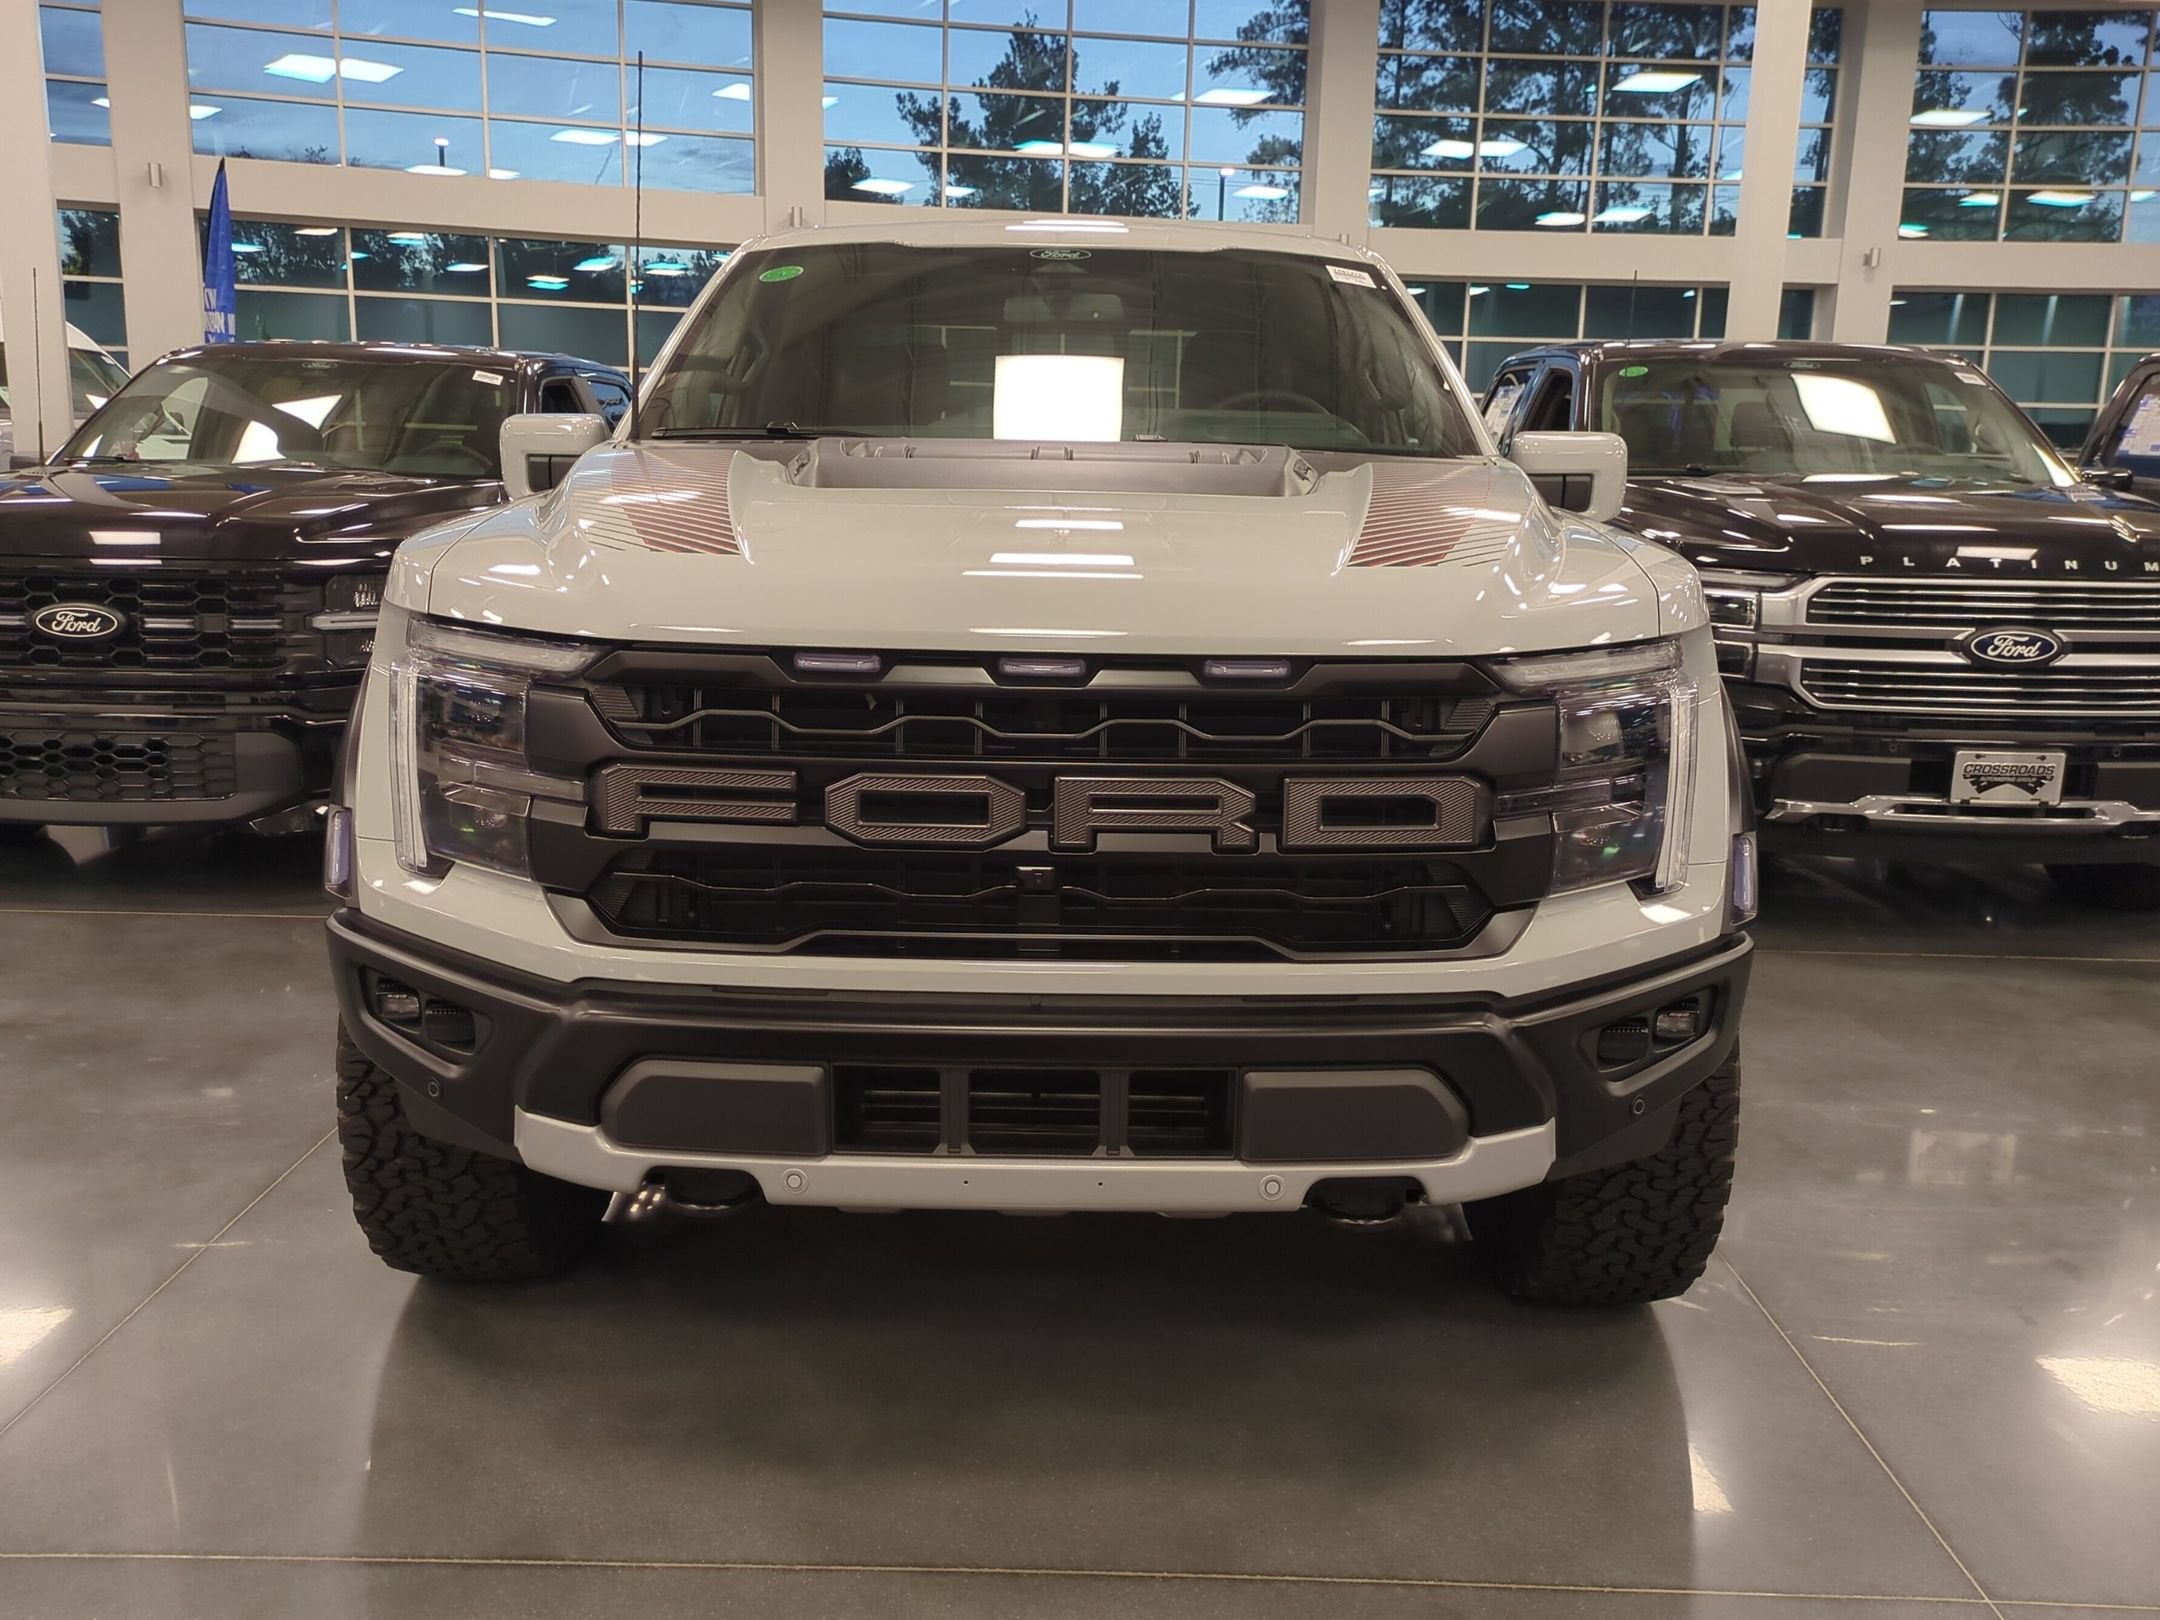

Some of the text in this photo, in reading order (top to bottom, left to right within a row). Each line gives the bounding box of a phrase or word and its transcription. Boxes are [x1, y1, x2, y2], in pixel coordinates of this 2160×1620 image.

[1860, 555, 2160, 572] PLATINUM
[51, 611, 101, 632] Ford
[1987, 635, 2041, 657] Ford
[1963, 763, 2056, 776] CROSSROADS
[601, 763, 1481, 848] FORD
